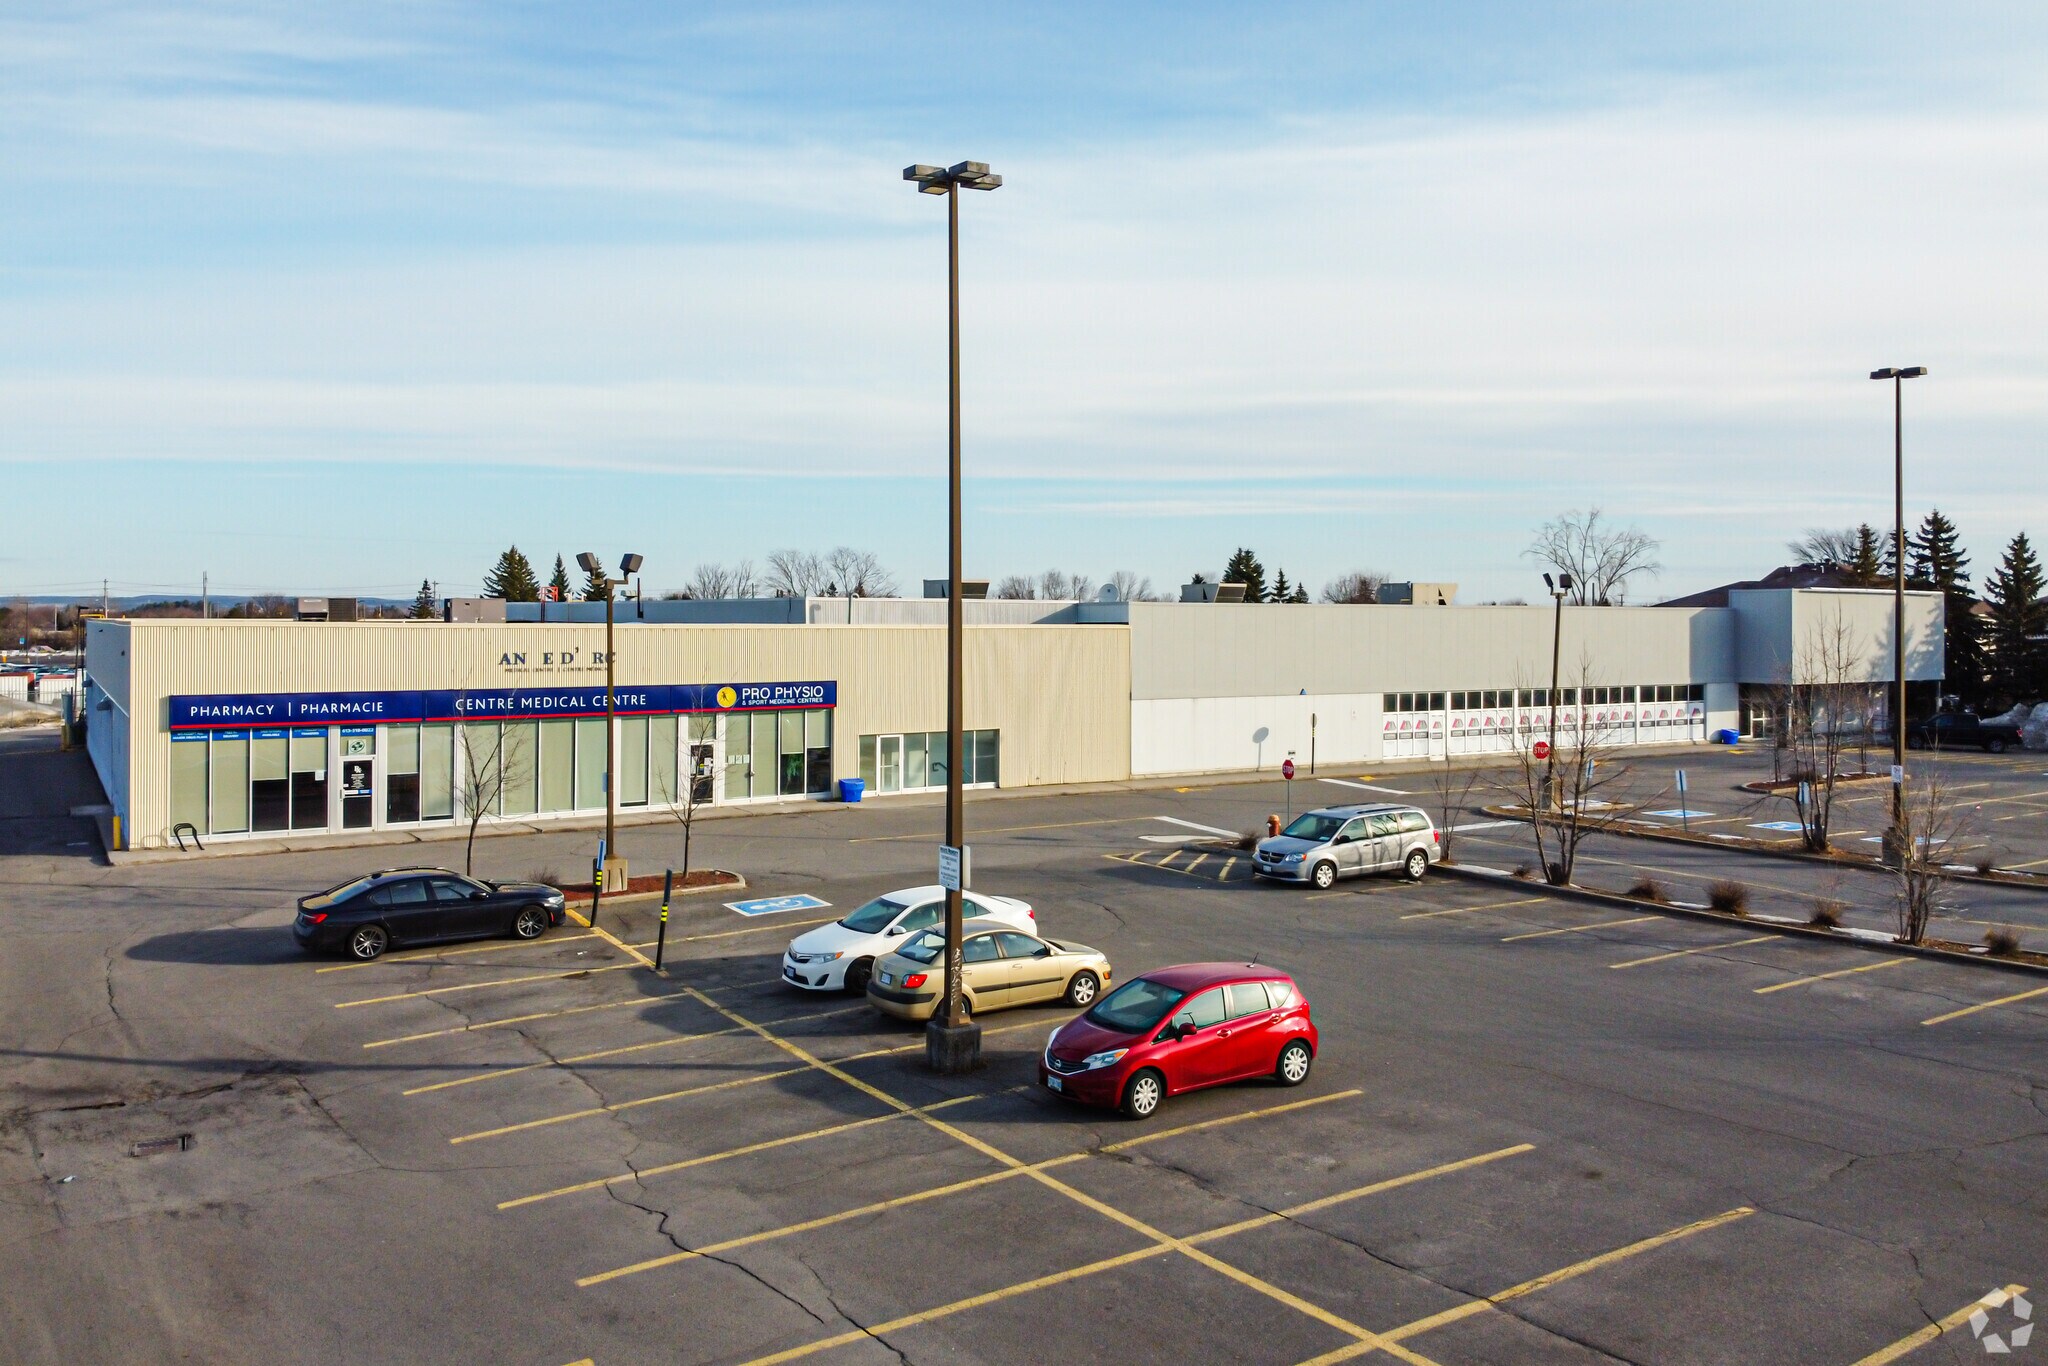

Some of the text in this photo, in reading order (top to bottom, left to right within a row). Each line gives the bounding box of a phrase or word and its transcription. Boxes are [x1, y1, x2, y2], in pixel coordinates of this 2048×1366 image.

[499, 652, 527, 665] AN
[742, 685, 824, 700] PRO PHYSIO
[190, 701, 384, 717] PHARMACY PHARMACIE
[455, 694, 646, 710] CENTRE MEDICAL CENTRE
[1533, 746, 1549, 754] STOP
